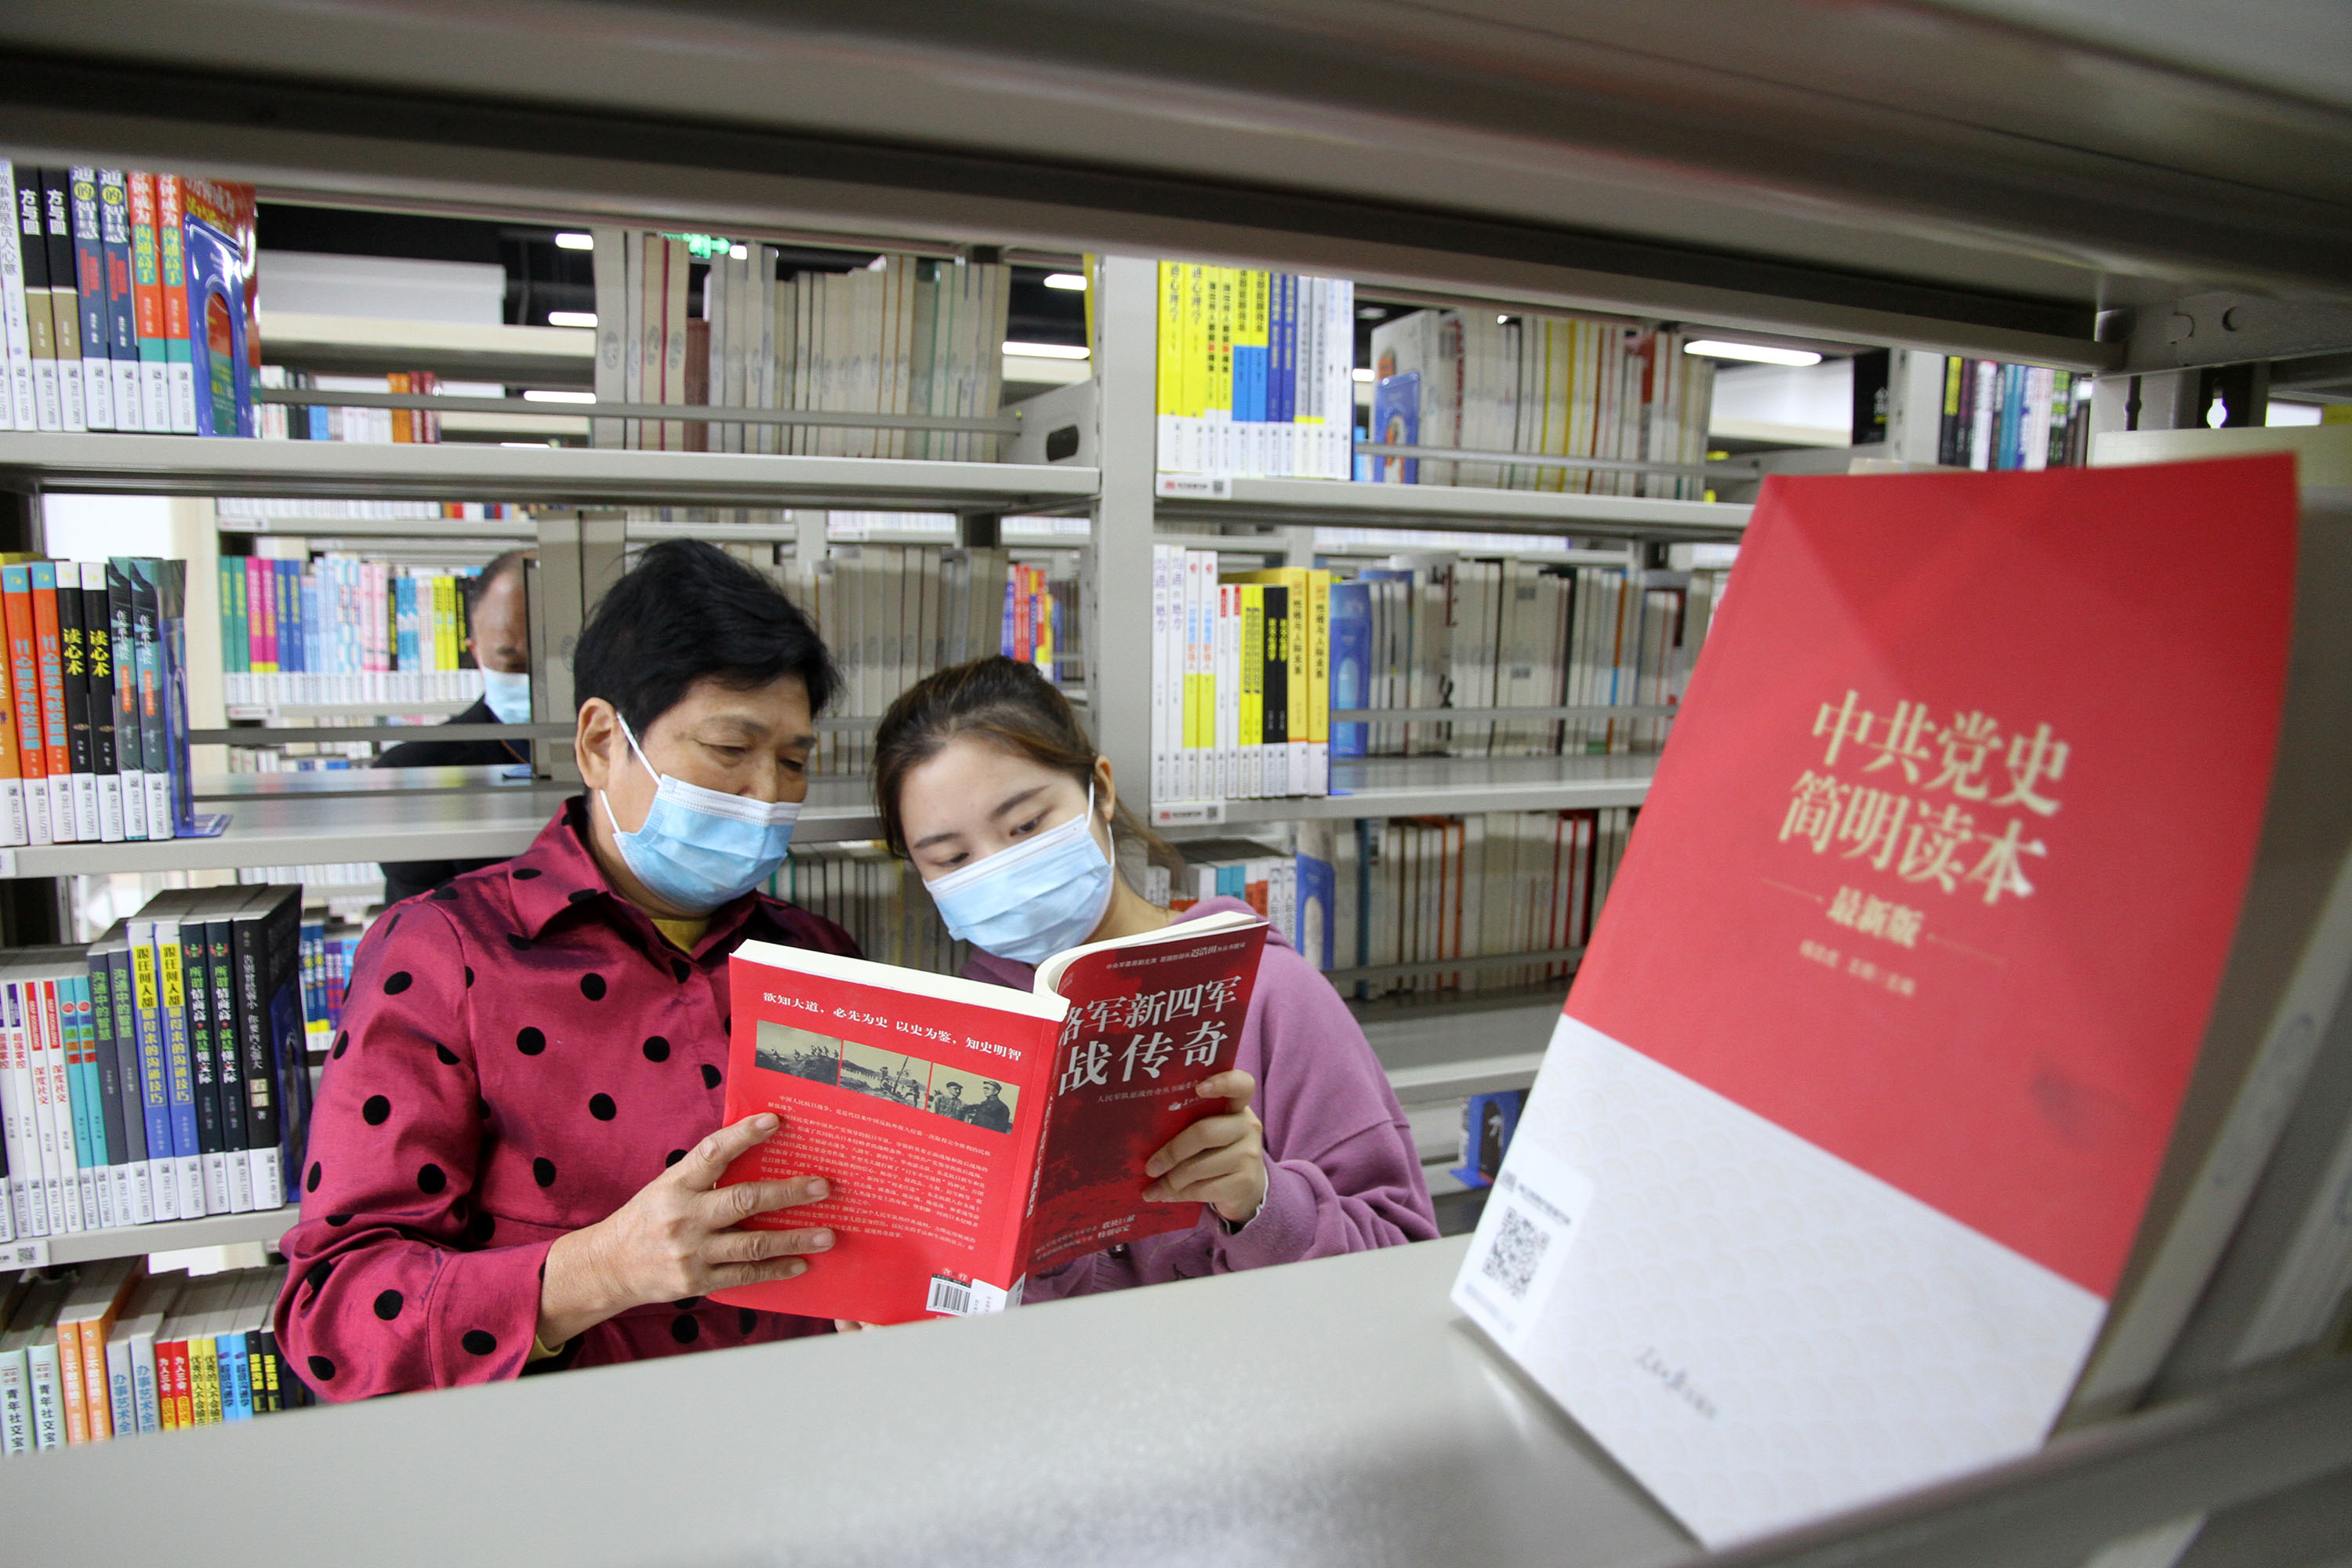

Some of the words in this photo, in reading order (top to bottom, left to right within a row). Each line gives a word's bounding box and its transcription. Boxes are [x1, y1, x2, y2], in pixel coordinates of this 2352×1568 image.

[20, 189, 40, 235] 方与圆
[47, 189, 67, 235] 方与圆
[64, 628, 84, 675] 读心术
[89, 630, 111, 677] 读心术
[1812, 690, 2070, 816] 中共党史
[1778, 770, 2046, 906] 简明读本
[1828, 885, 1925, 949] 最新版
[1058, 1021, 1229, 1097] 战传奇
